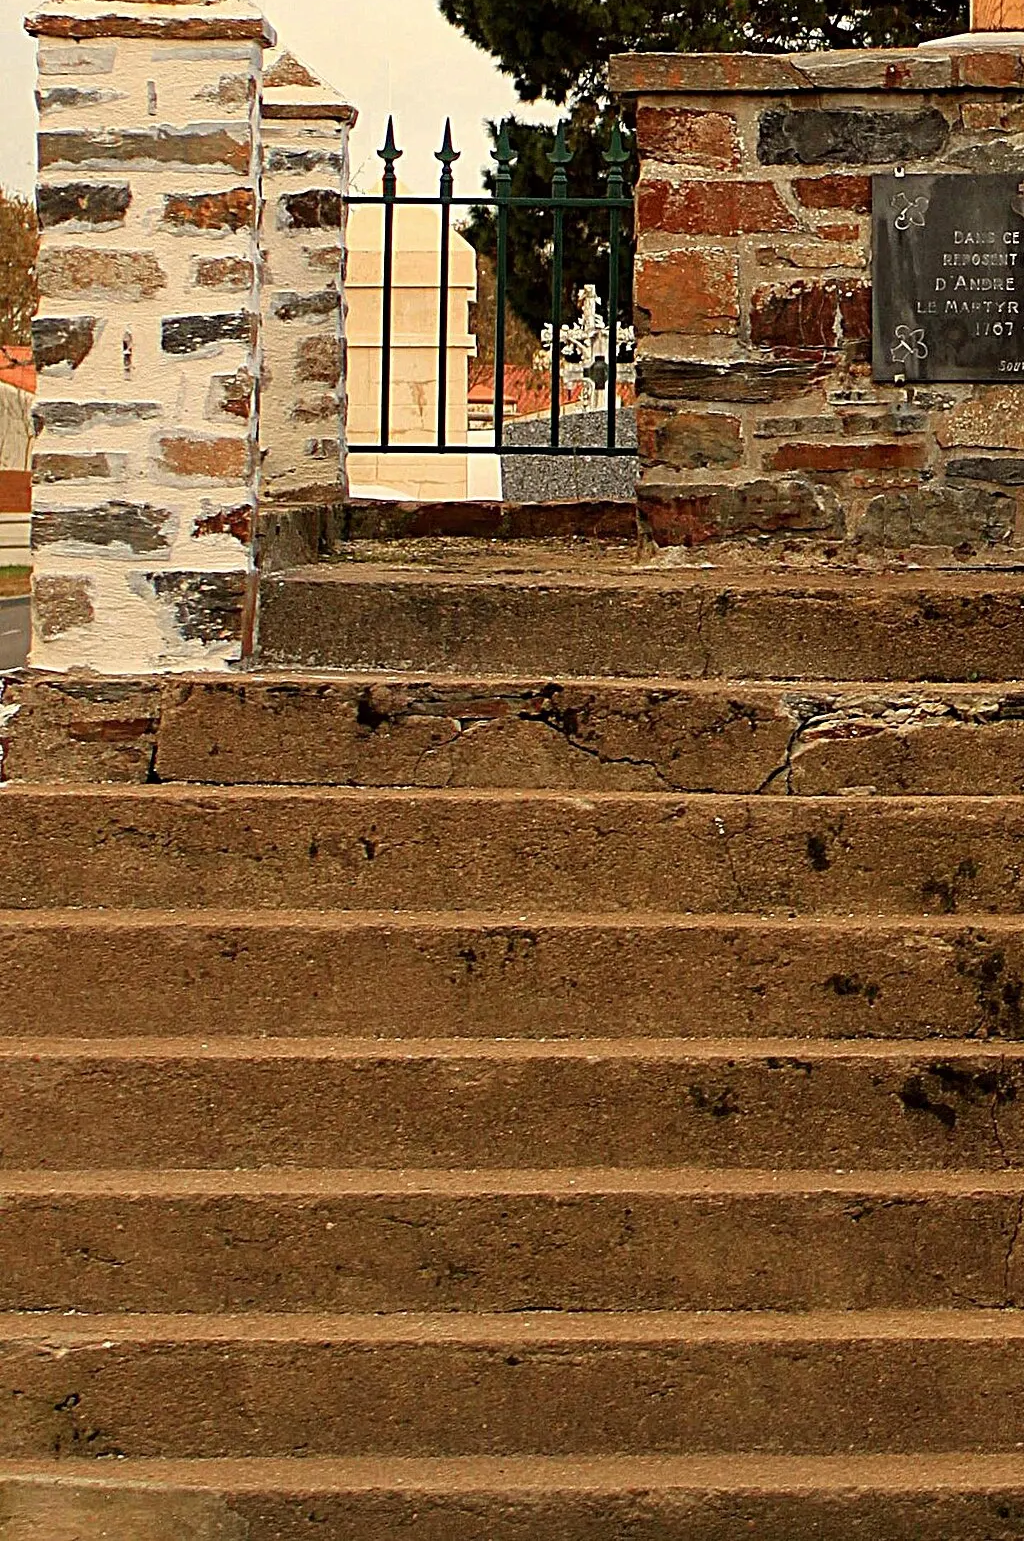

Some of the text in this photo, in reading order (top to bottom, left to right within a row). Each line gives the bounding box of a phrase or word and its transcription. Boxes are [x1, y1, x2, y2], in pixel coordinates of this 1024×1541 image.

[1002, 231, 1020, 244] CE
[943, 253, 1018, 266] REPOSENT
[916, 301, 937, 314] LE
[944, 300, 1019, 314] MARTYR
